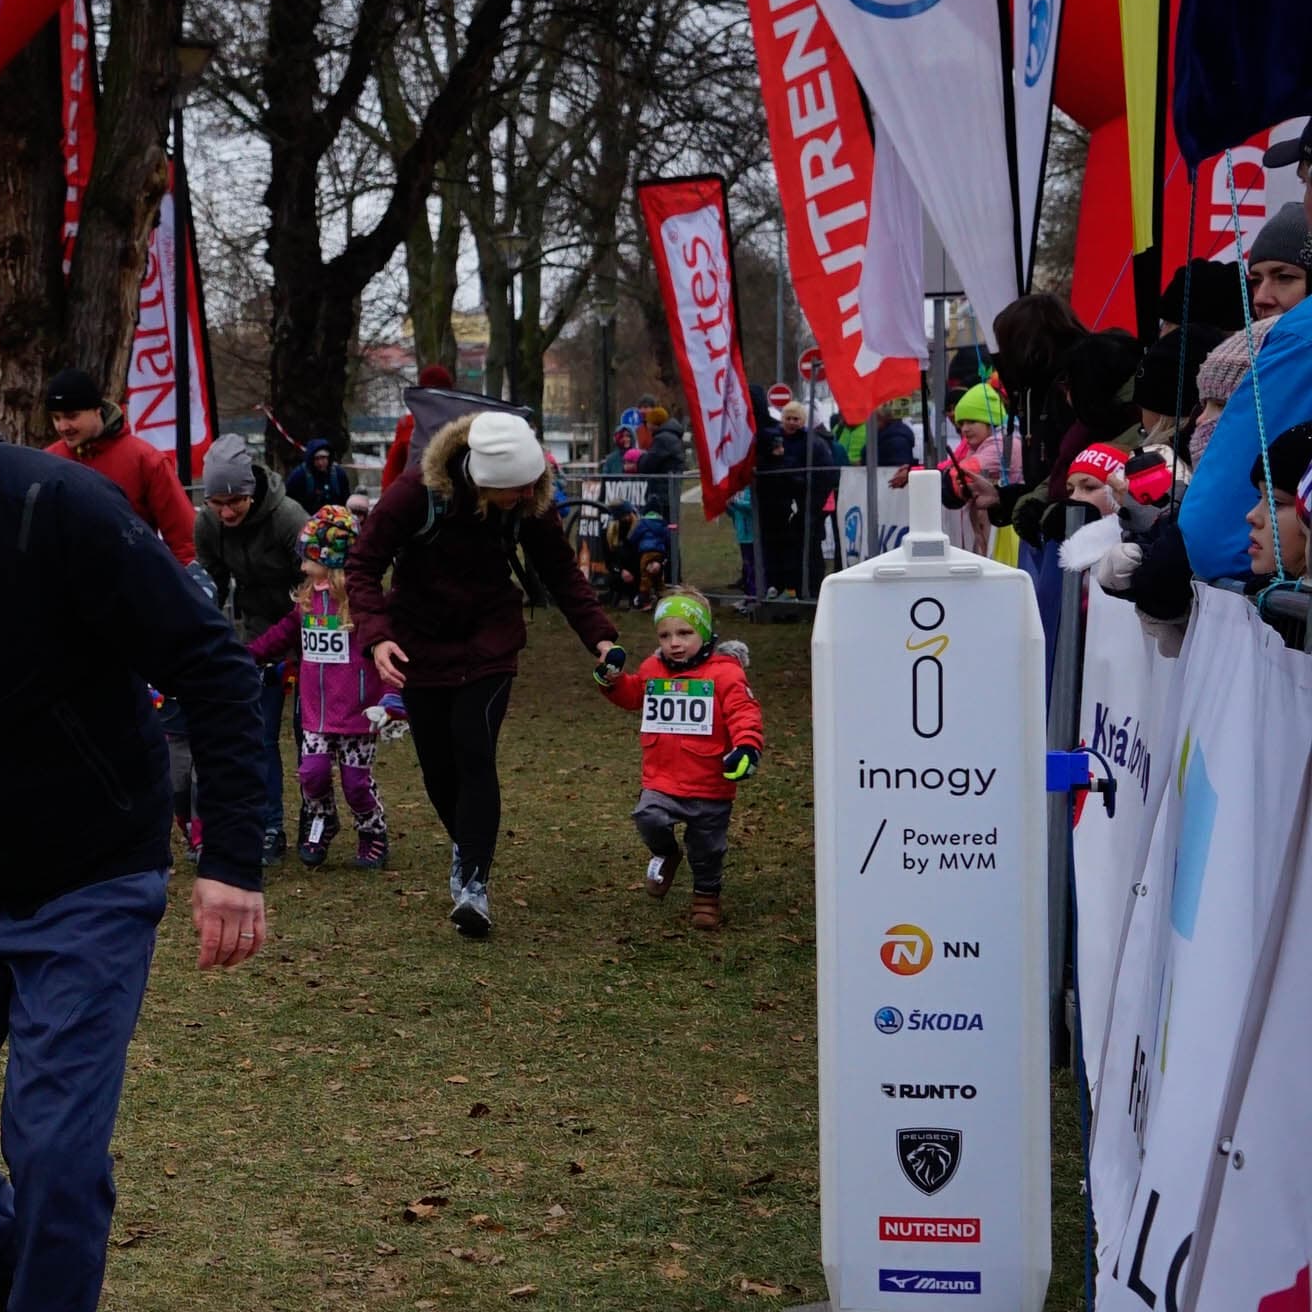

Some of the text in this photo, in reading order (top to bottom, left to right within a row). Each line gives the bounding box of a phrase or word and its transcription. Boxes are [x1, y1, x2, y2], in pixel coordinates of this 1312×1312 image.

[134, 229, 177, 435] Nart
[303, 630, 343, 653] 3056
[646, 697, 706, 723] 3010
[859, 759, 997, 796] innogy
[903, 827, 998, 846] Powered
[903, 851, 996, 875] by MVM
[943, 941, 980, 959] NN
[907, 1009, 984, 1031] ŠKODA
[899, 1084, 977, 1100] RUNTO
[902, 1133, 957, 1142] PEUGEOT
[884, 1222, 977, 1238] NUTREND
